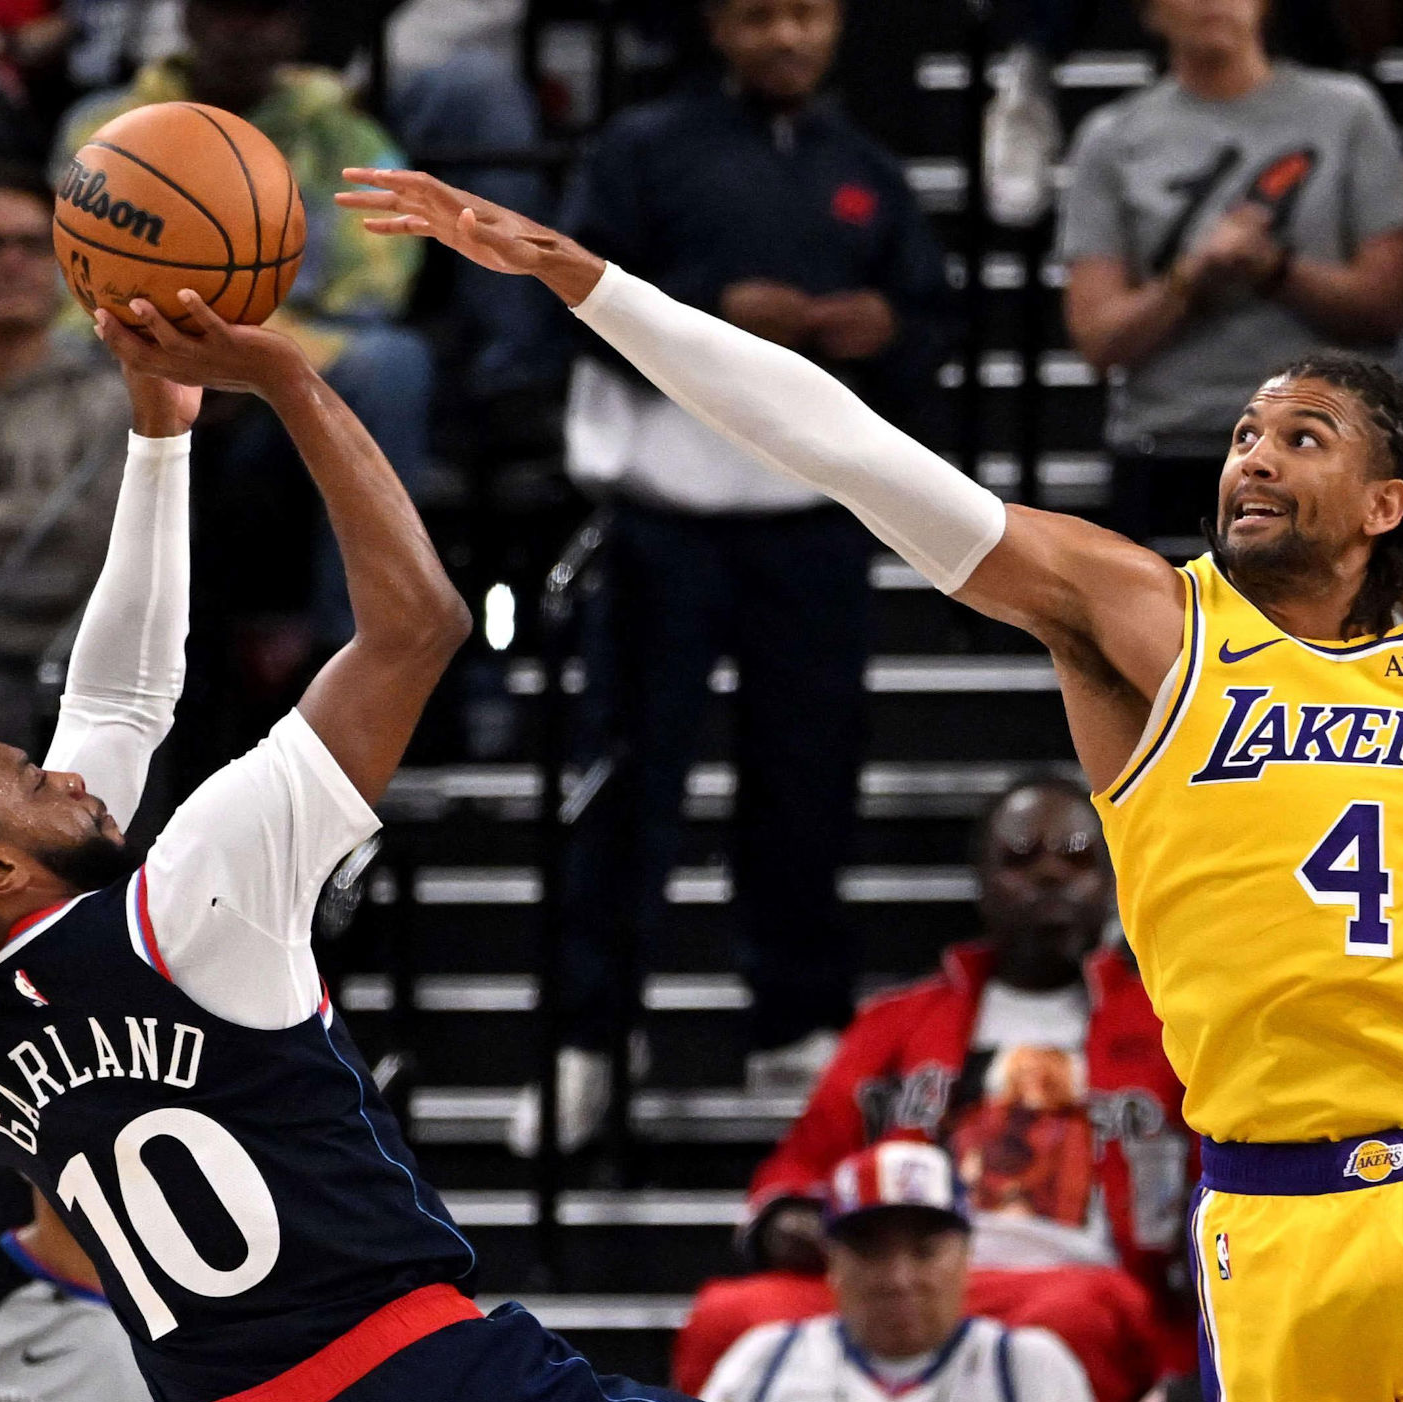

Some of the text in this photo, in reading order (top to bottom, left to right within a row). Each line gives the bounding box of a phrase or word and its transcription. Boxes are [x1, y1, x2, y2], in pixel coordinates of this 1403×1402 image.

[57, 158, 165, 246] Wilson
[1294, 800, 1393, 958] 4
[56, 1107, 281, 1341] 10
